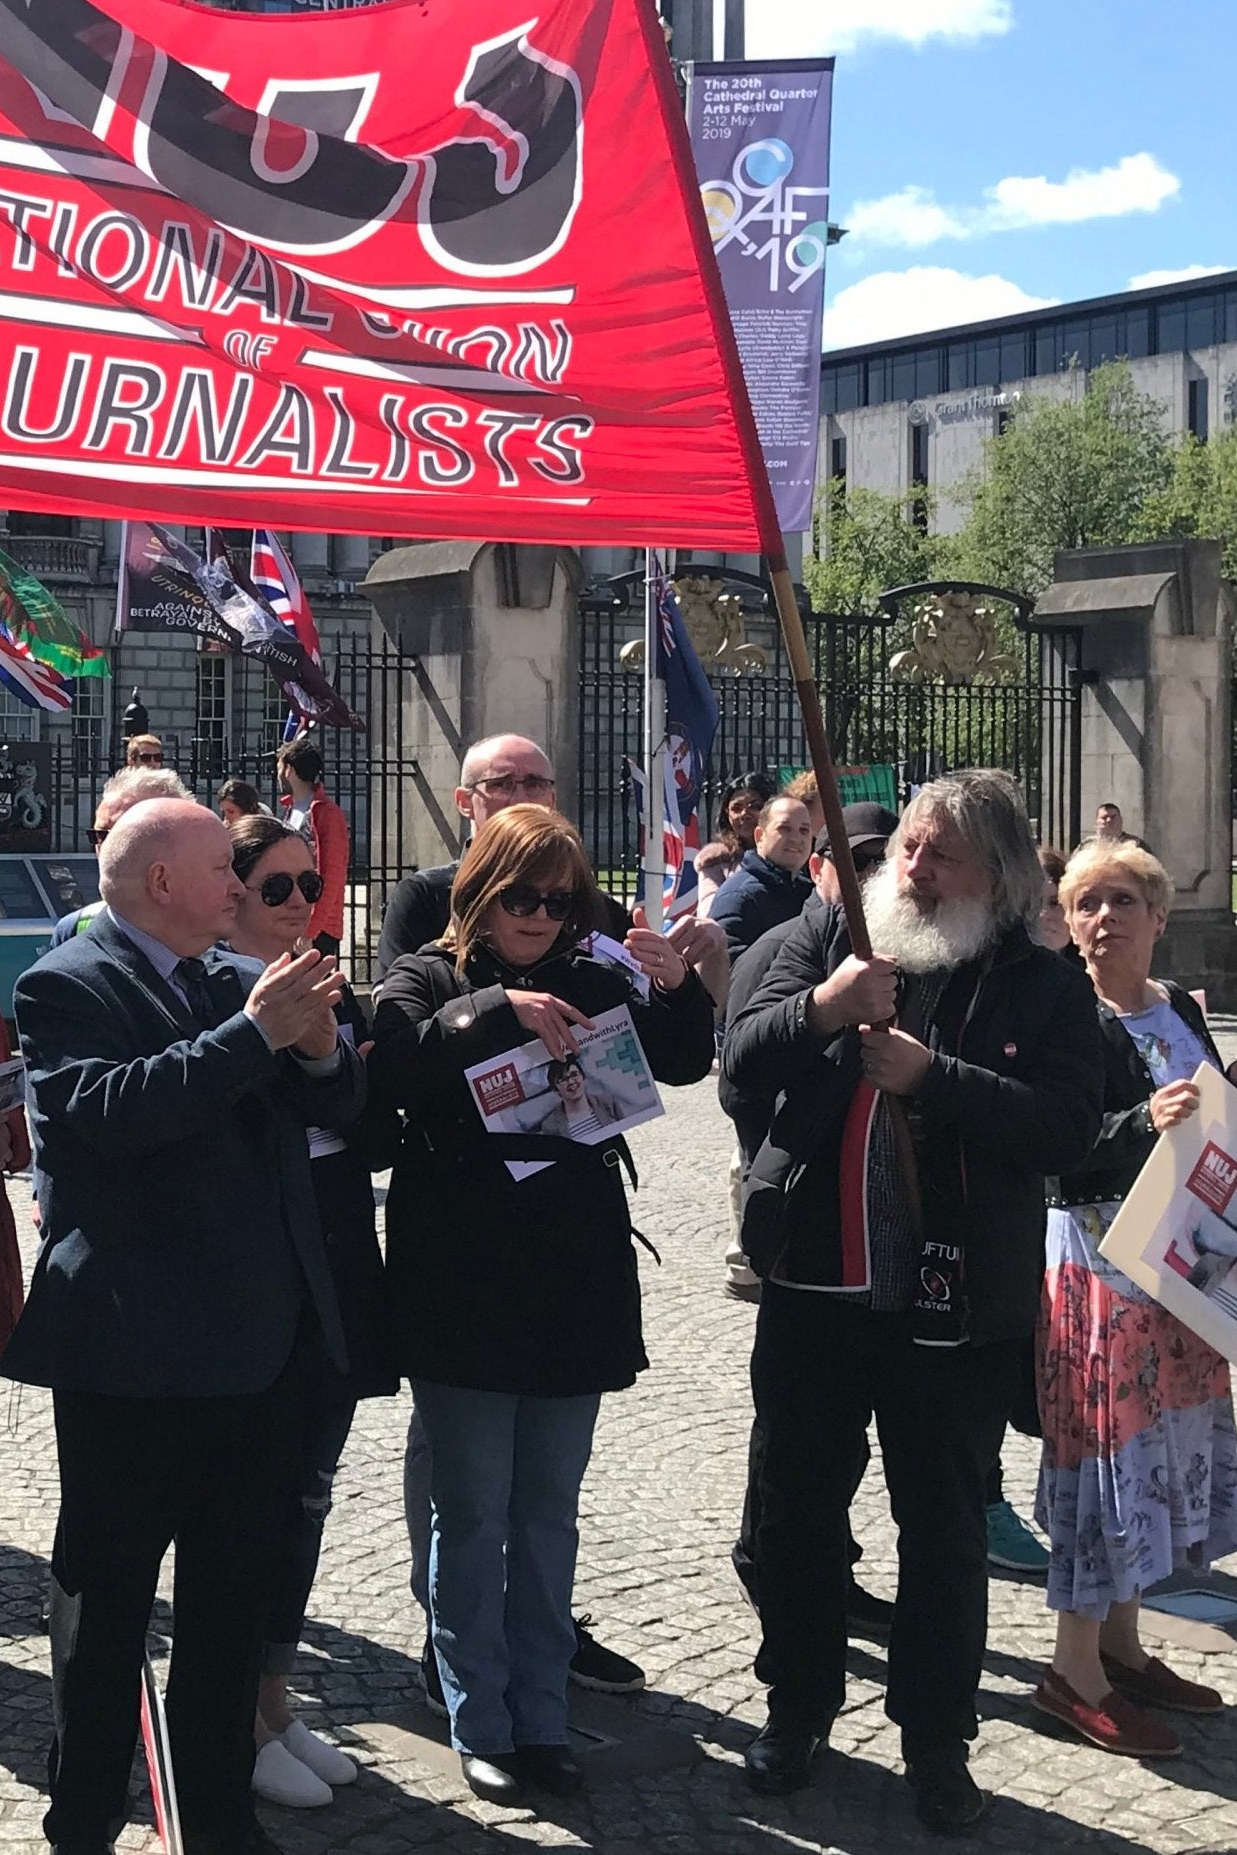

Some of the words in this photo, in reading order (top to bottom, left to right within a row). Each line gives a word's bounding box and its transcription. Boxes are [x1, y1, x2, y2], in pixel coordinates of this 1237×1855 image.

[705, 79, 728, 90] The
[732, 78, 762, 89] 20th
[704, 90, 766, 103] Cathedral
[769, 88, 818, 100] Quarter
[703, 103, 731, 114] Arts
[734, 101, 784, 114] Festival
[703, 116, 728, 127] 2-12
[730, 115, 757, 128] May
[702, 129, 732, 140] 2019
[222, 329, 278, 370] OF
[166, 617, 232, 642] GOVERN
[478, 1069, 513, 1094] NUJ
[1204, 1150, 1237, 1185] NUJ
